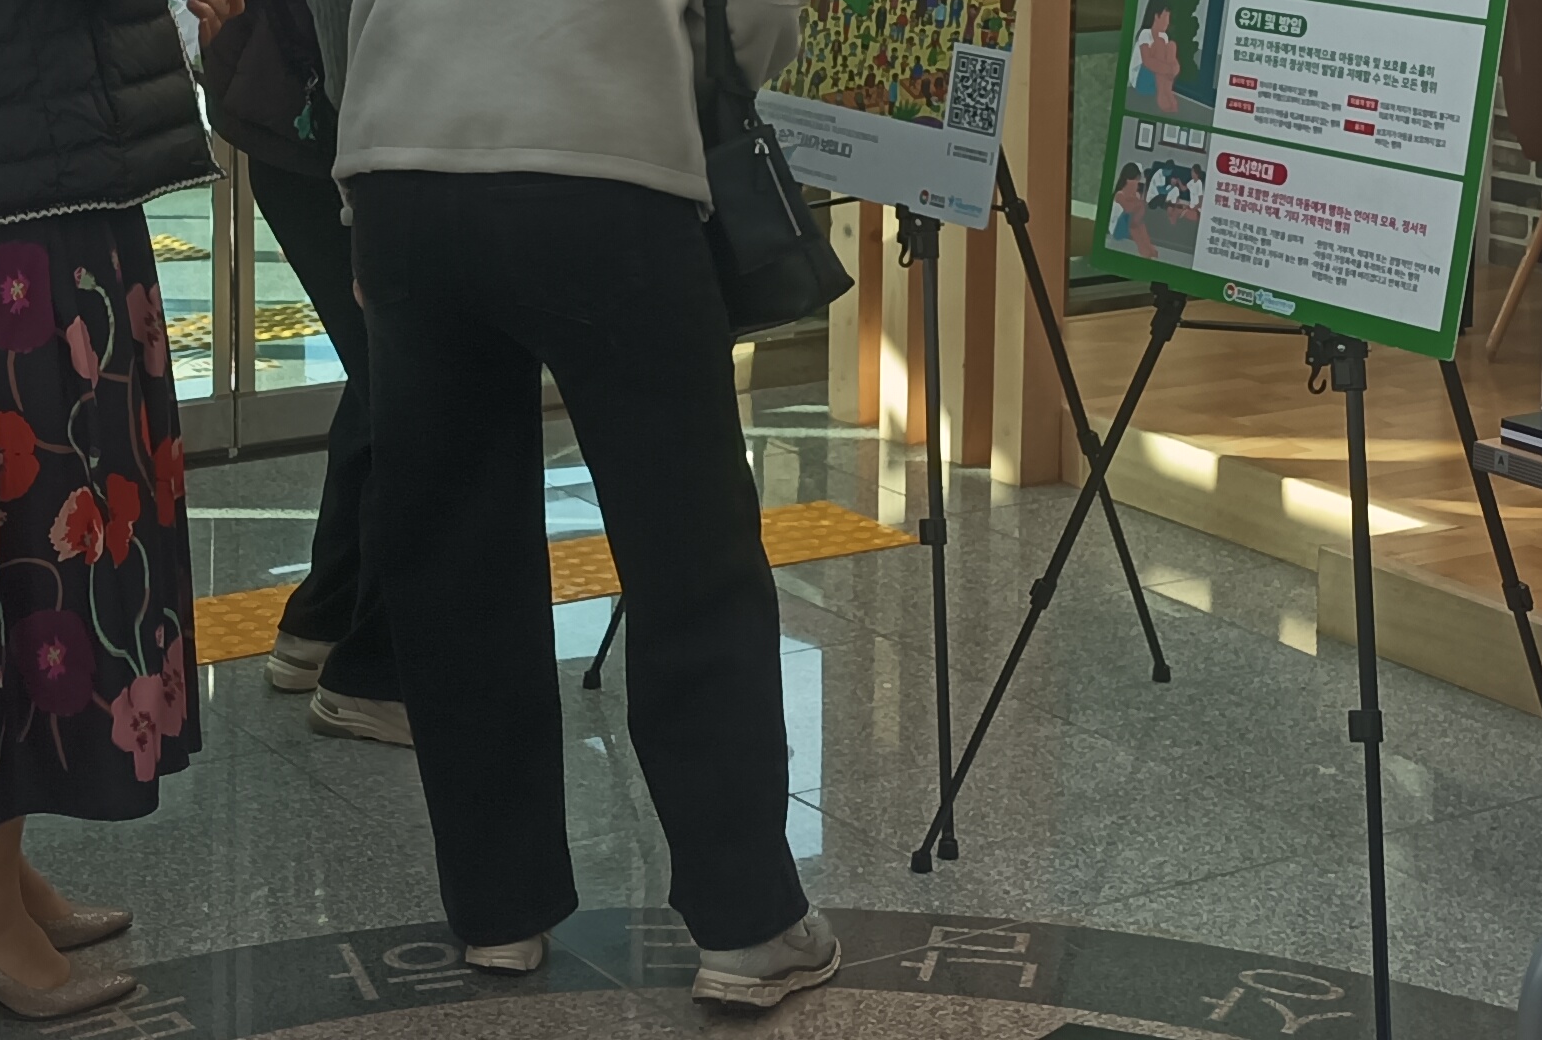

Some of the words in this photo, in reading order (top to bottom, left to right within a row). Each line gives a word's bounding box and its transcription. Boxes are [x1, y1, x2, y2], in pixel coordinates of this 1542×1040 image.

[1239, 10, 1258, 26] 유기
[1265, 13, 1276, 30] 및
[1278, 15, 1303, 35] 방임
[1228, 157, 1274, 181] 정서학대
[1334, 221, 1350, 234] 행위
